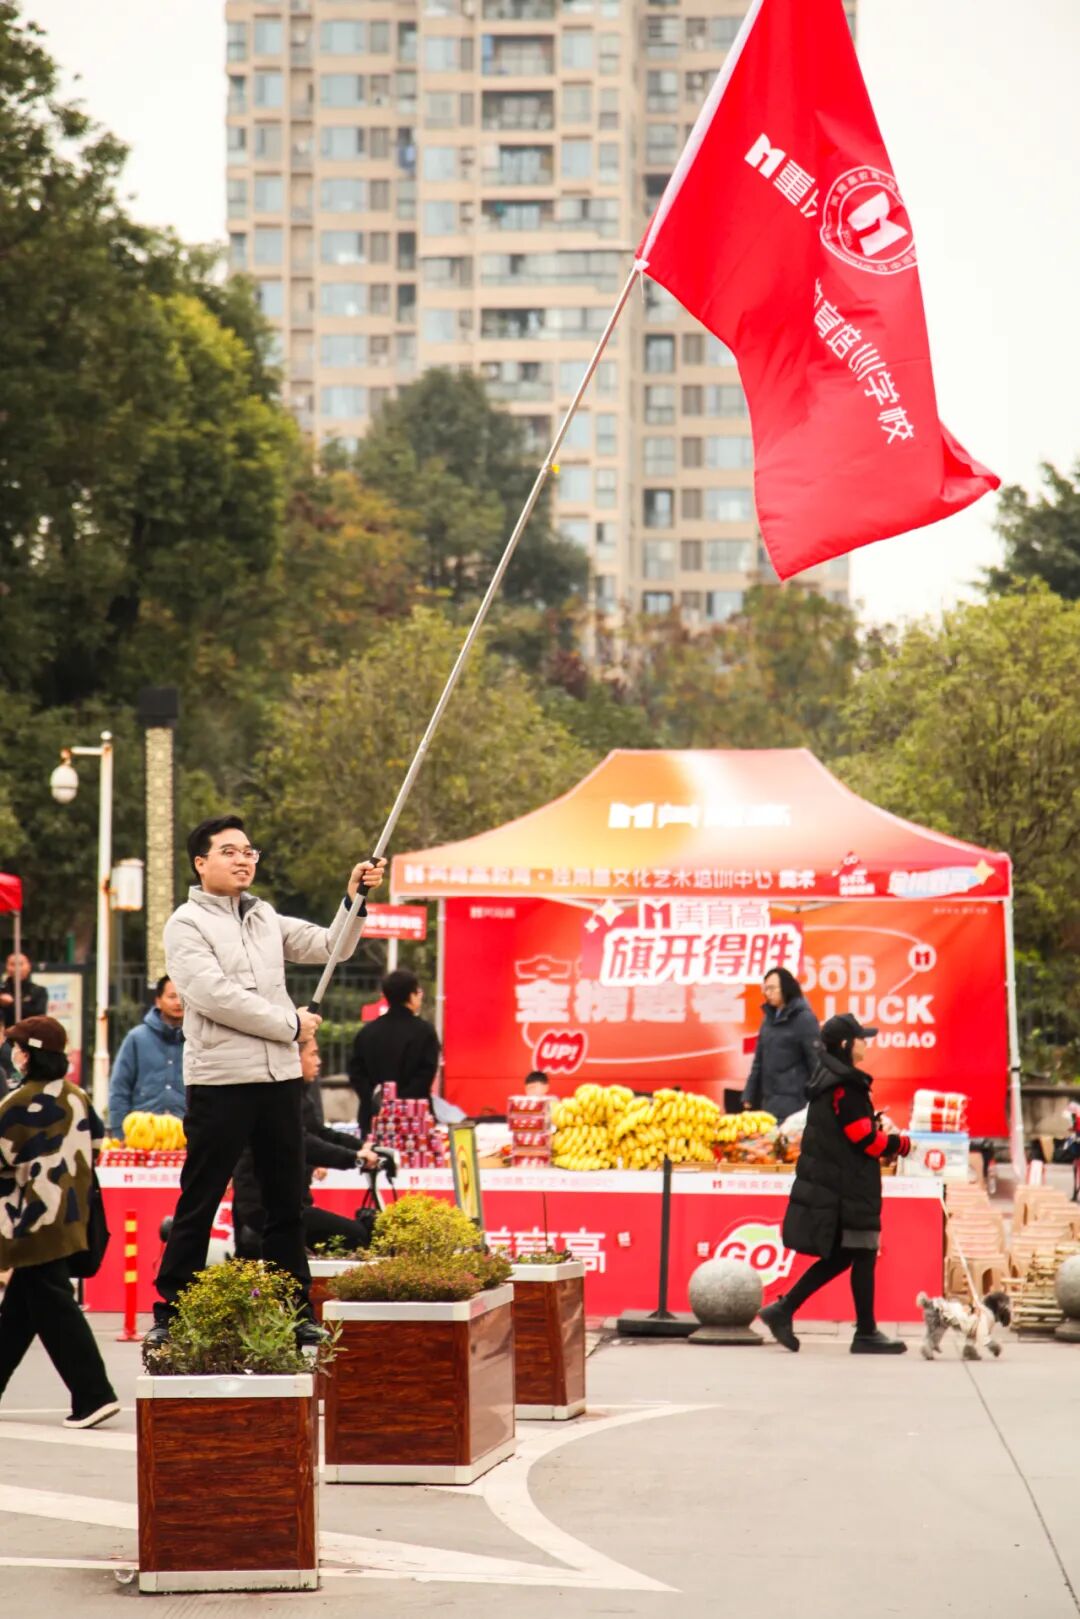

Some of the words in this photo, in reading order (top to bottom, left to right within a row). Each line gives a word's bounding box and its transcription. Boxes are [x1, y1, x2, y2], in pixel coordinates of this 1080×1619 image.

[814, 278, 914, 444] 育培训学校
[608, 932, 794, 979] 旗开得胜
[541, 1043, 580, 1061] UP!
[720, 1242, 792, 1271] GO!
